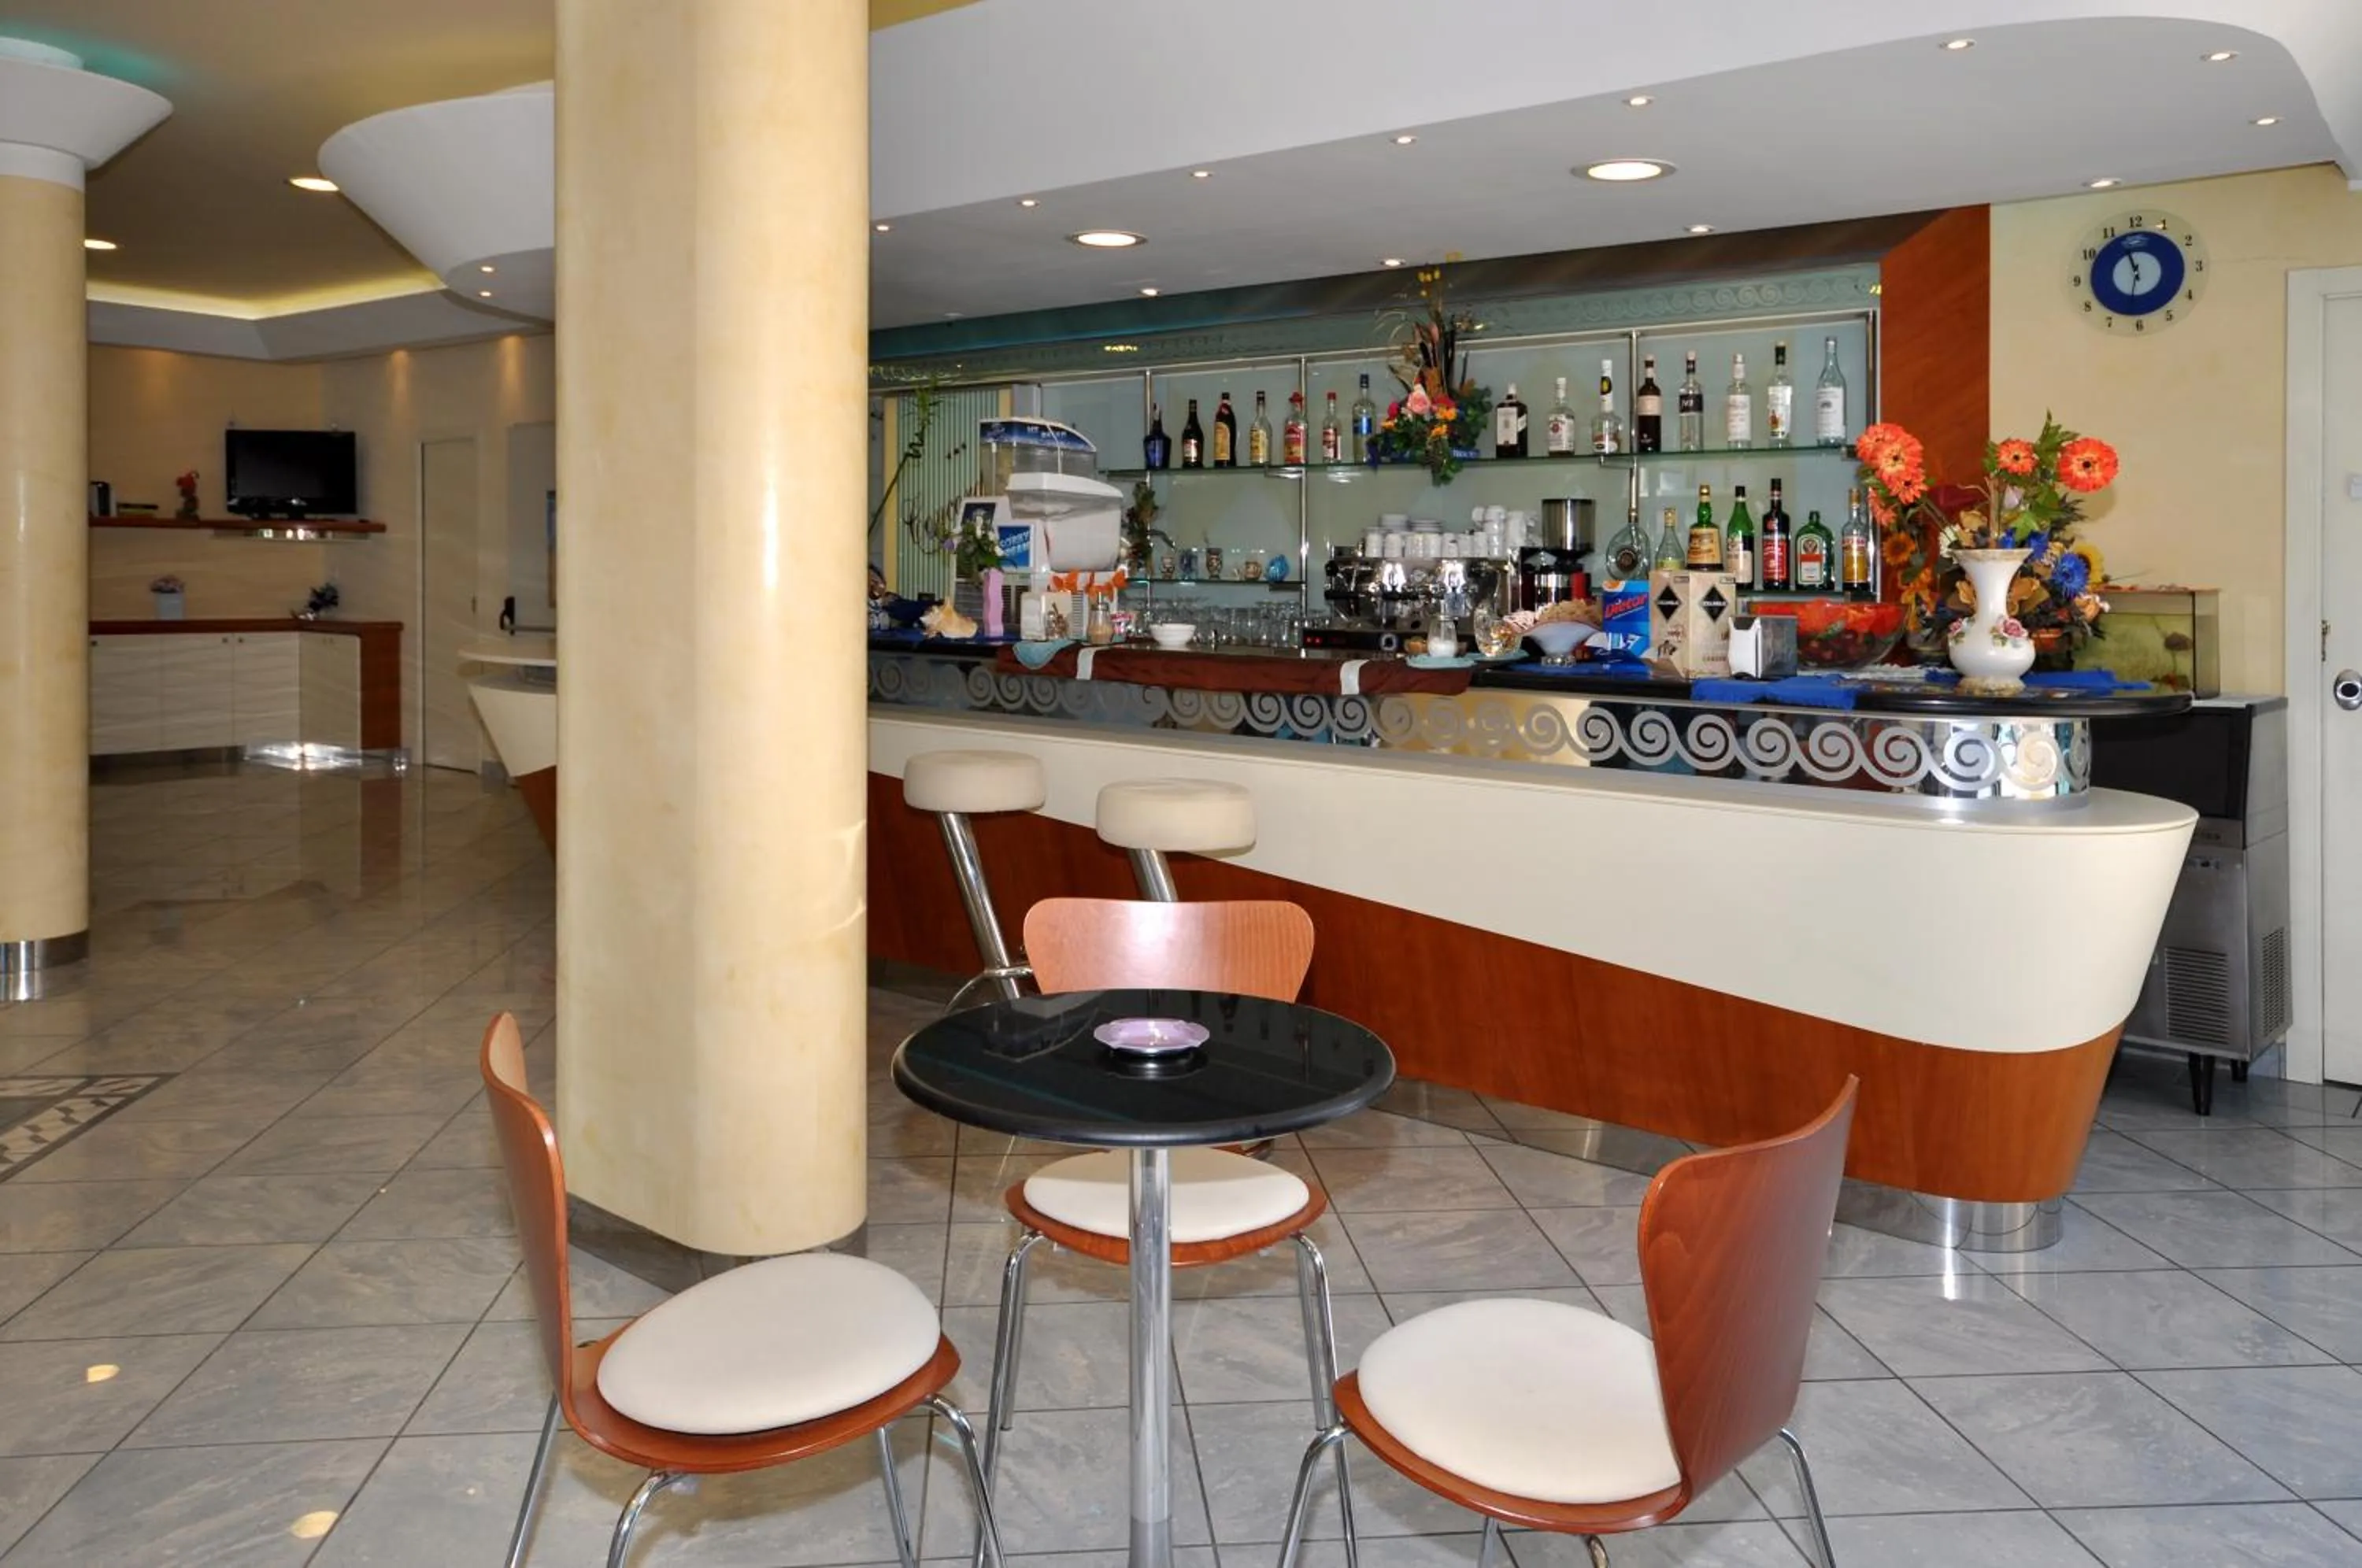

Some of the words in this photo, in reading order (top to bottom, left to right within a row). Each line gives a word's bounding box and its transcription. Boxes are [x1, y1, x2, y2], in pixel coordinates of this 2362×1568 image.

[2129, 216, 2142, 228] 12
[2161, 219, 2168, 231] 1
[2103, 227, 2116, 239] 11
[2185, 235, 2193, 246] 2
[2082, 249, 2096, 261] 10
[2195, 261, 2203, 272] 3
[2073, 276, 2081, 287] 9
[2185, 289, 2193, 300] 4
[2084, 301, 2092, 312] 8
[2166, 310, 2174, 321] 5
[2106, 316, 2112, 327] 7
[2136, 320, 2144, 331] 6
